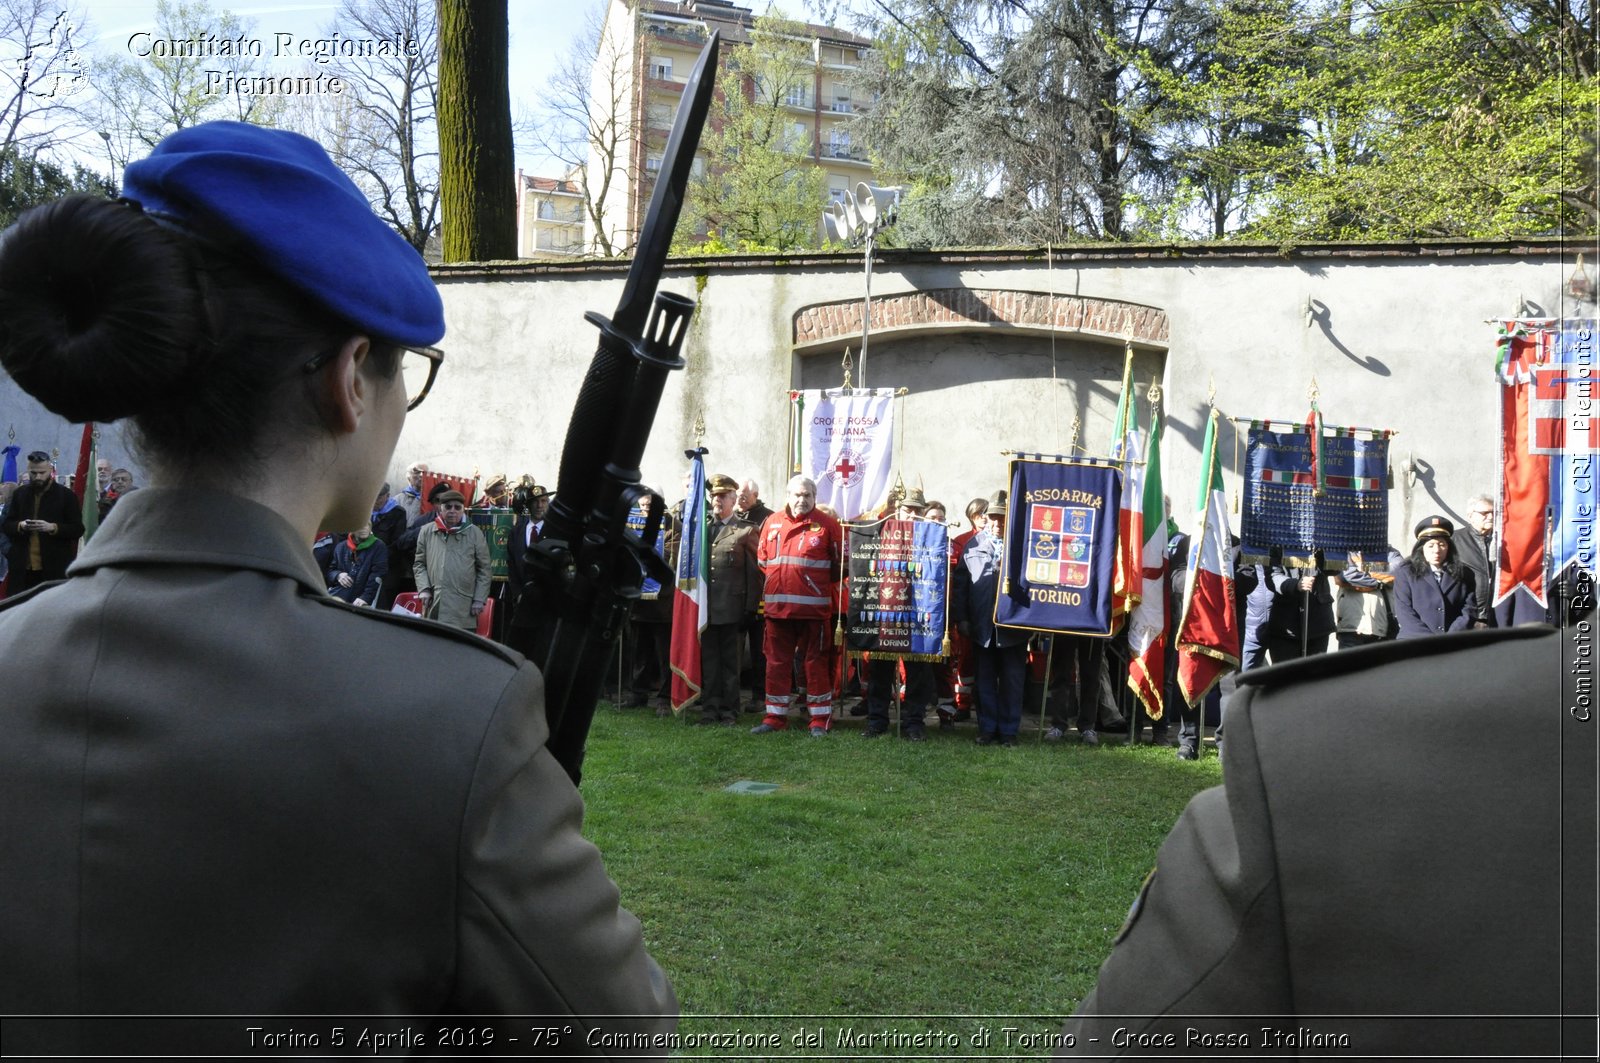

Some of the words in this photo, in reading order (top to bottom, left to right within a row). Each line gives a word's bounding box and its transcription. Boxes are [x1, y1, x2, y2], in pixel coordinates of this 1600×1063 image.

[813, 416, 844, 426] CROCE
[848, 416, 880, 426] ROSSA
[825, 427, 866, 436] ITALIANA
[1302, 453, 1344, 466] PINTE
[1024, 488, 1103, 510] ASSOARMA
[1029, 588, 1082, 607] TORINO
[852, 626, 879, 634] SEZIONE
[879, 639, 910, 647] TORINO
